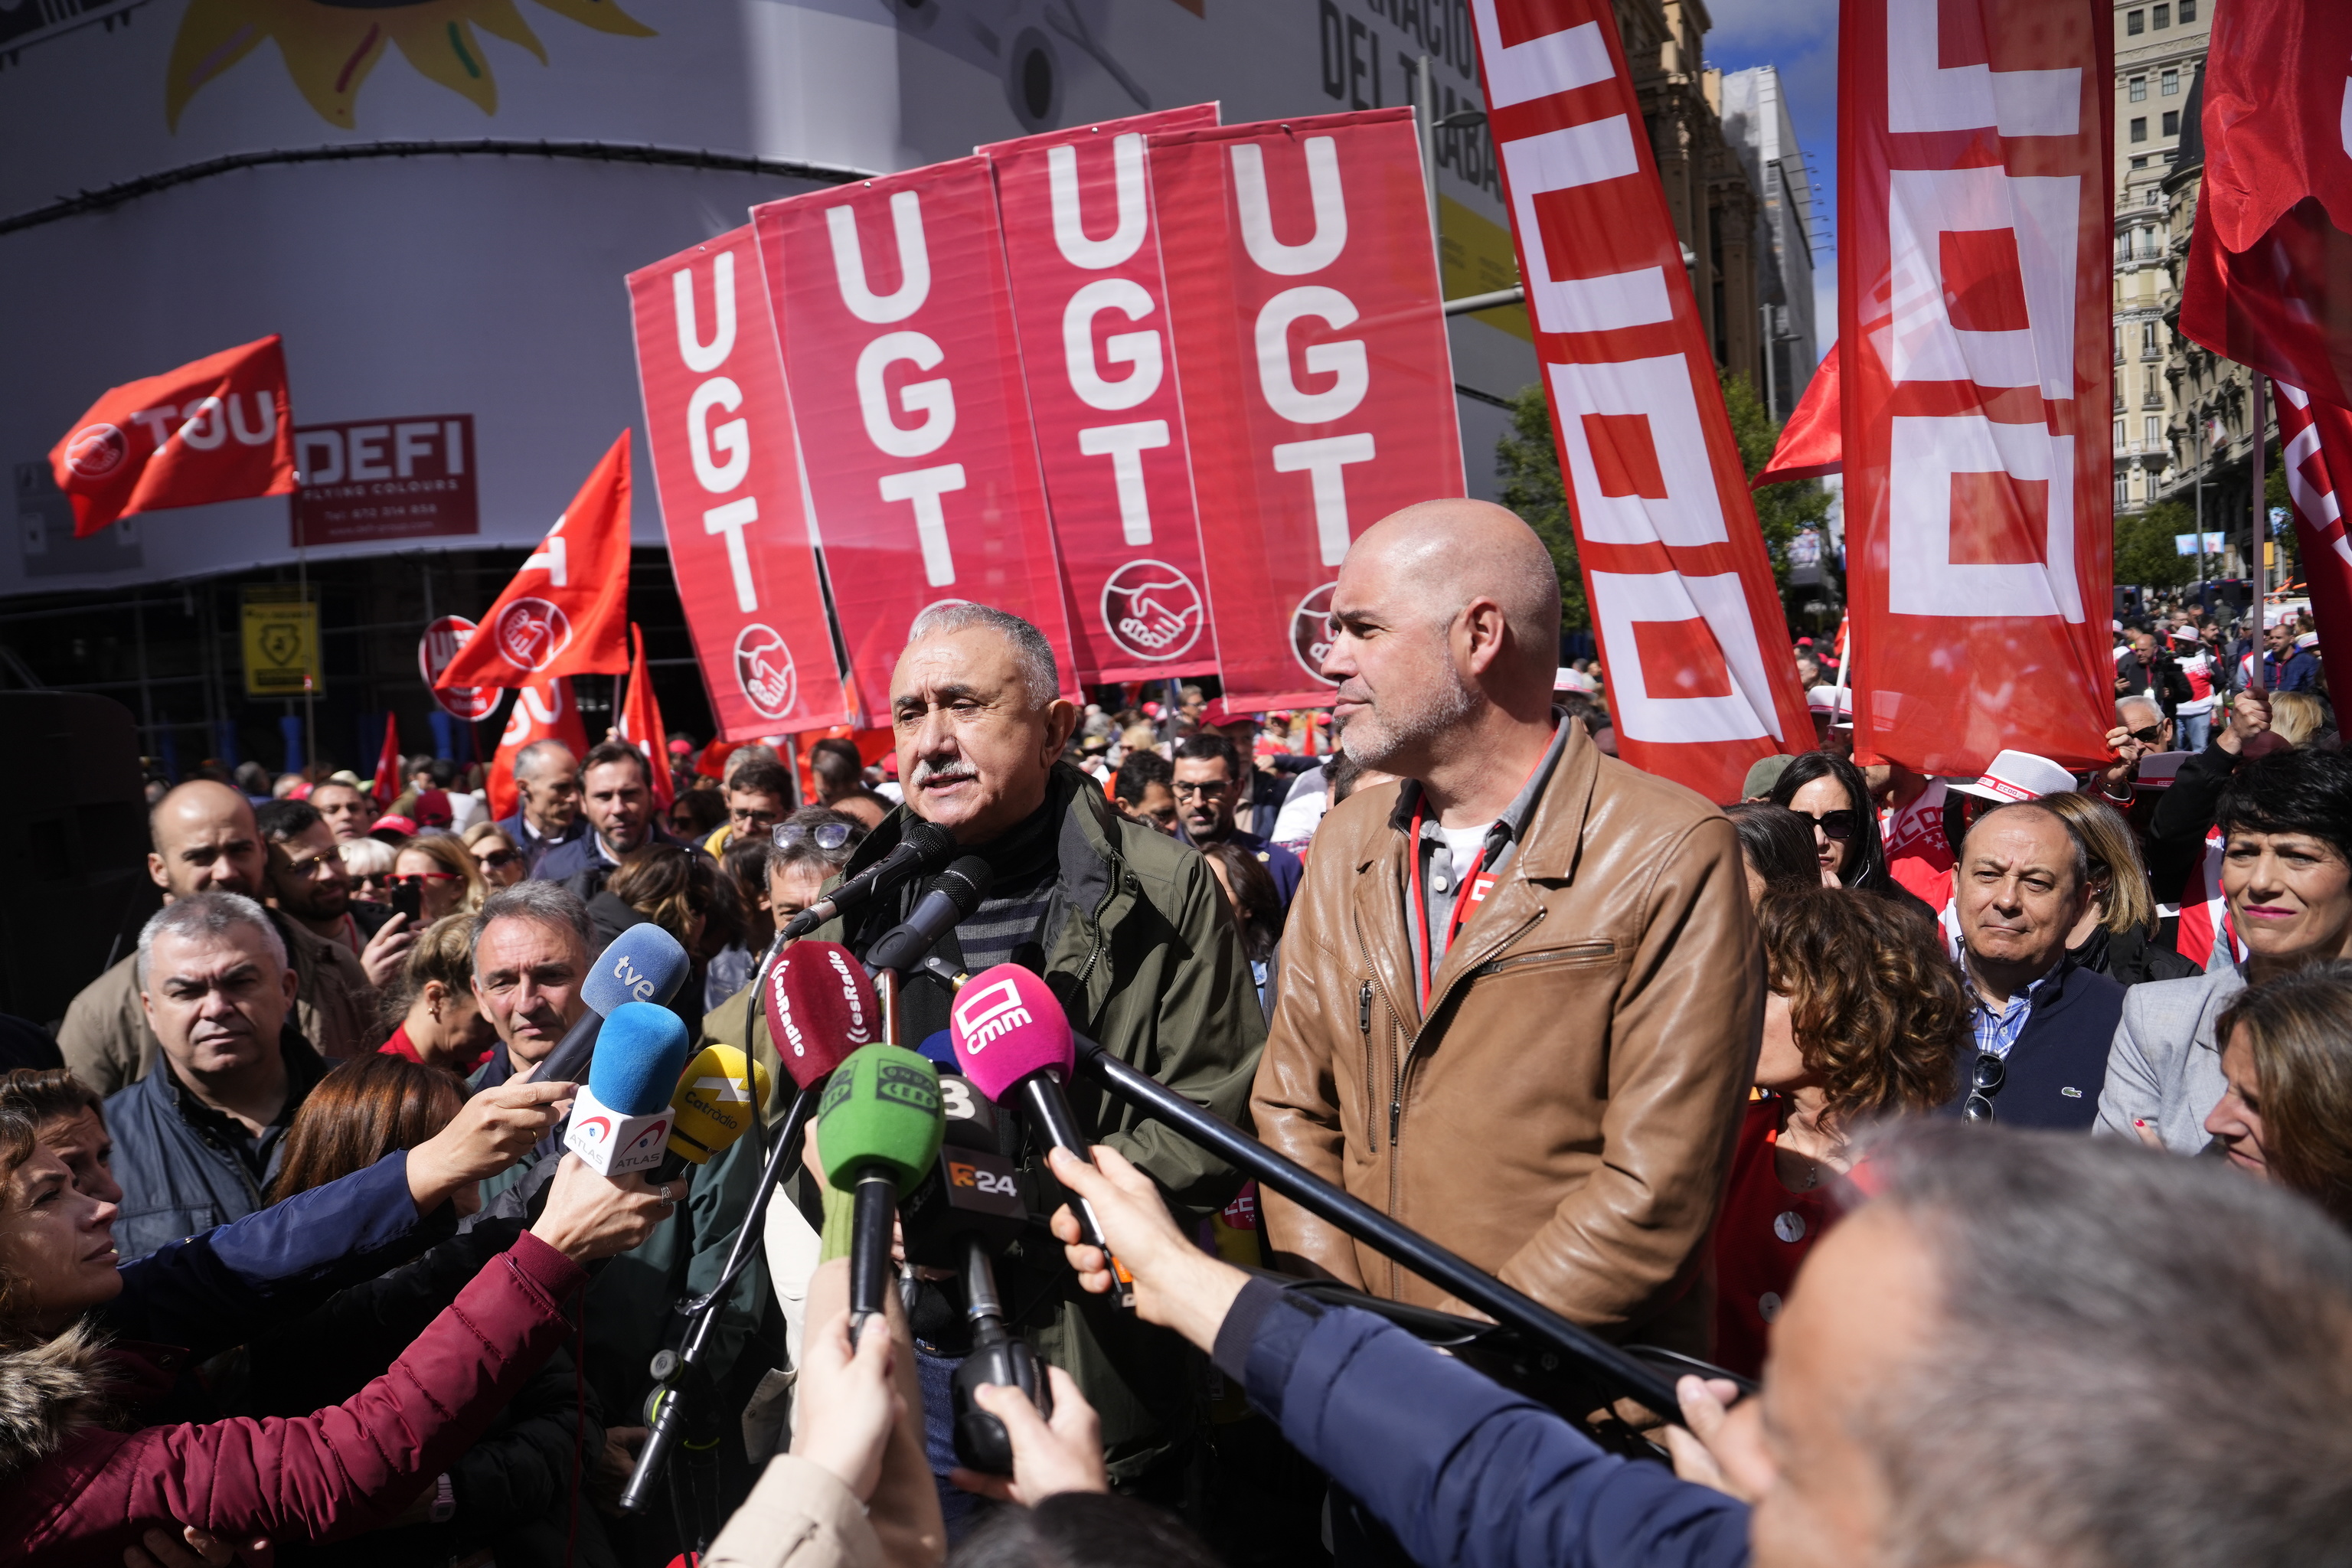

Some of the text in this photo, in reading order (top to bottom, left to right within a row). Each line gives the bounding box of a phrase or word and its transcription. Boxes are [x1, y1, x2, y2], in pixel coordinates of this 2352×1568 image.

[1321, 0, 1380, 110] DEL
[1047, 132, 1171, 546] UGT
[1230, 135, 1376, 567] UGT
[825, 190, 966, 587] UGT
[295, 421, 464, 486] DEFI
[672, 251, 758, 613] UGT
[371, 479, 459, 496] COLOURS
[1998, 783, 2018, 796] CCOO
[613, 955, 657, 1002] tve
[828, 950, 863, 1026] esRadio
[775, 975, 805, 1057] esRadio
[966, 1007, 1033, 1055] cmm
[684, 1090, 739, 1130] Catràdio
[887, 1081, 935, 1107] CERO
[569, 1133, 604, 1166] ATLAS
[615, 1152, 660, 1170] ATLAS
